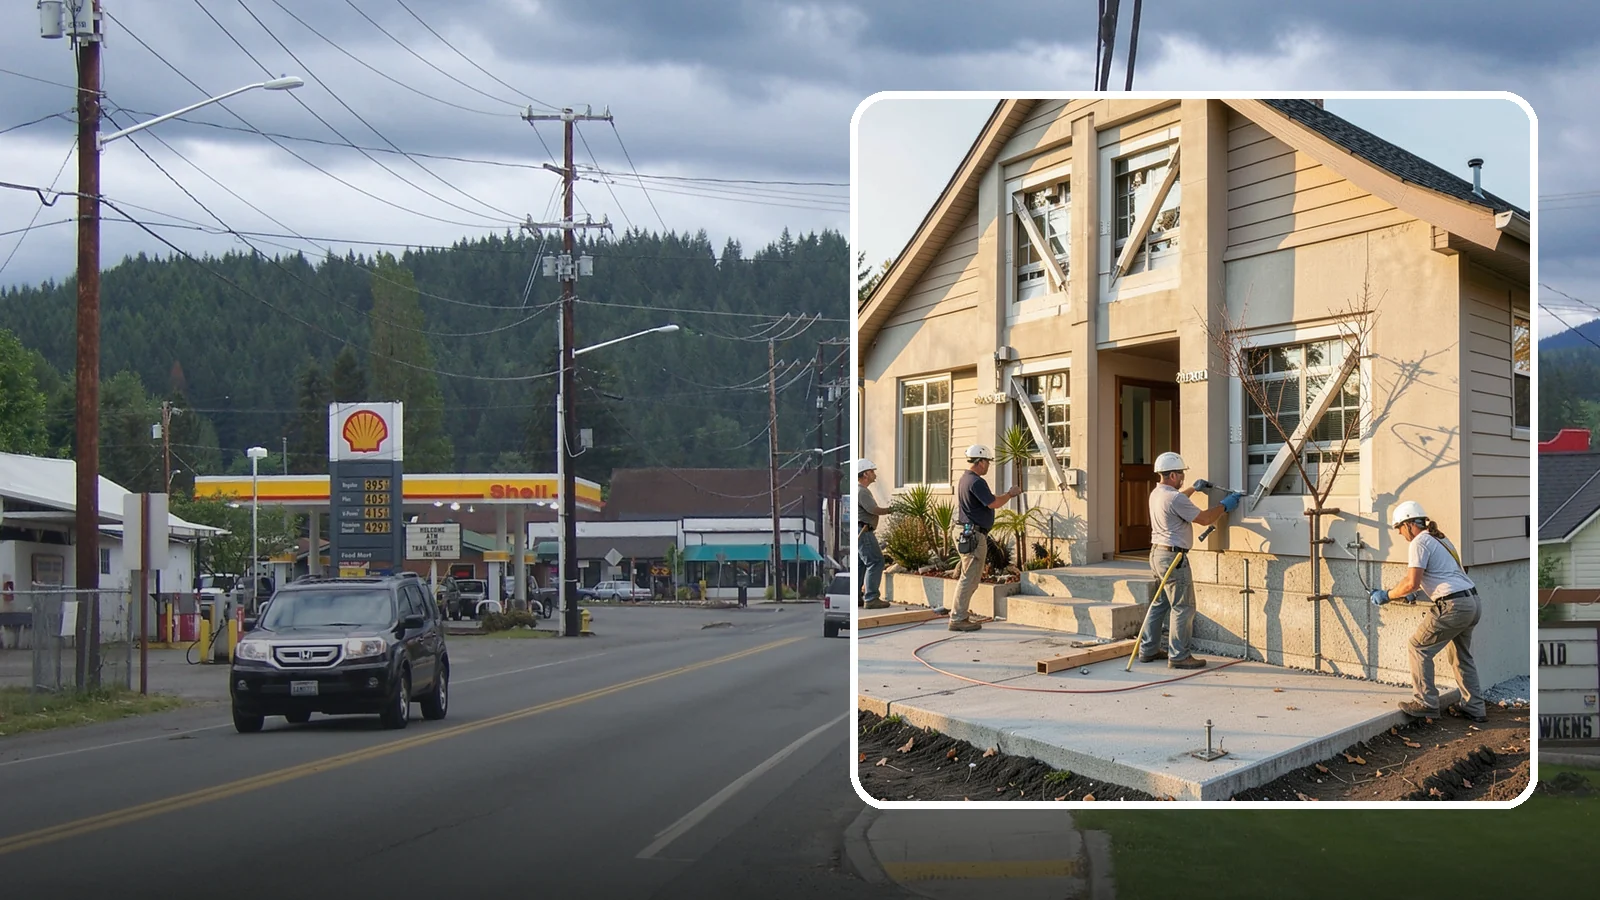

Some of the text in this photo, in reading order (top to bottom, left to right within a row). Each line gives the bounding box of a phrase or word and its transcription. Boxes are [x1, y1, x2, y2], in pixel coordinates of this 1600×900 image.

[365, 480, 383, 490] 395
[490, 484, 547, 499] Shell
[365, 494, 383, 504] 405
[365, 508, 383, 518] 415
[365, 522, 383, 532] 429
